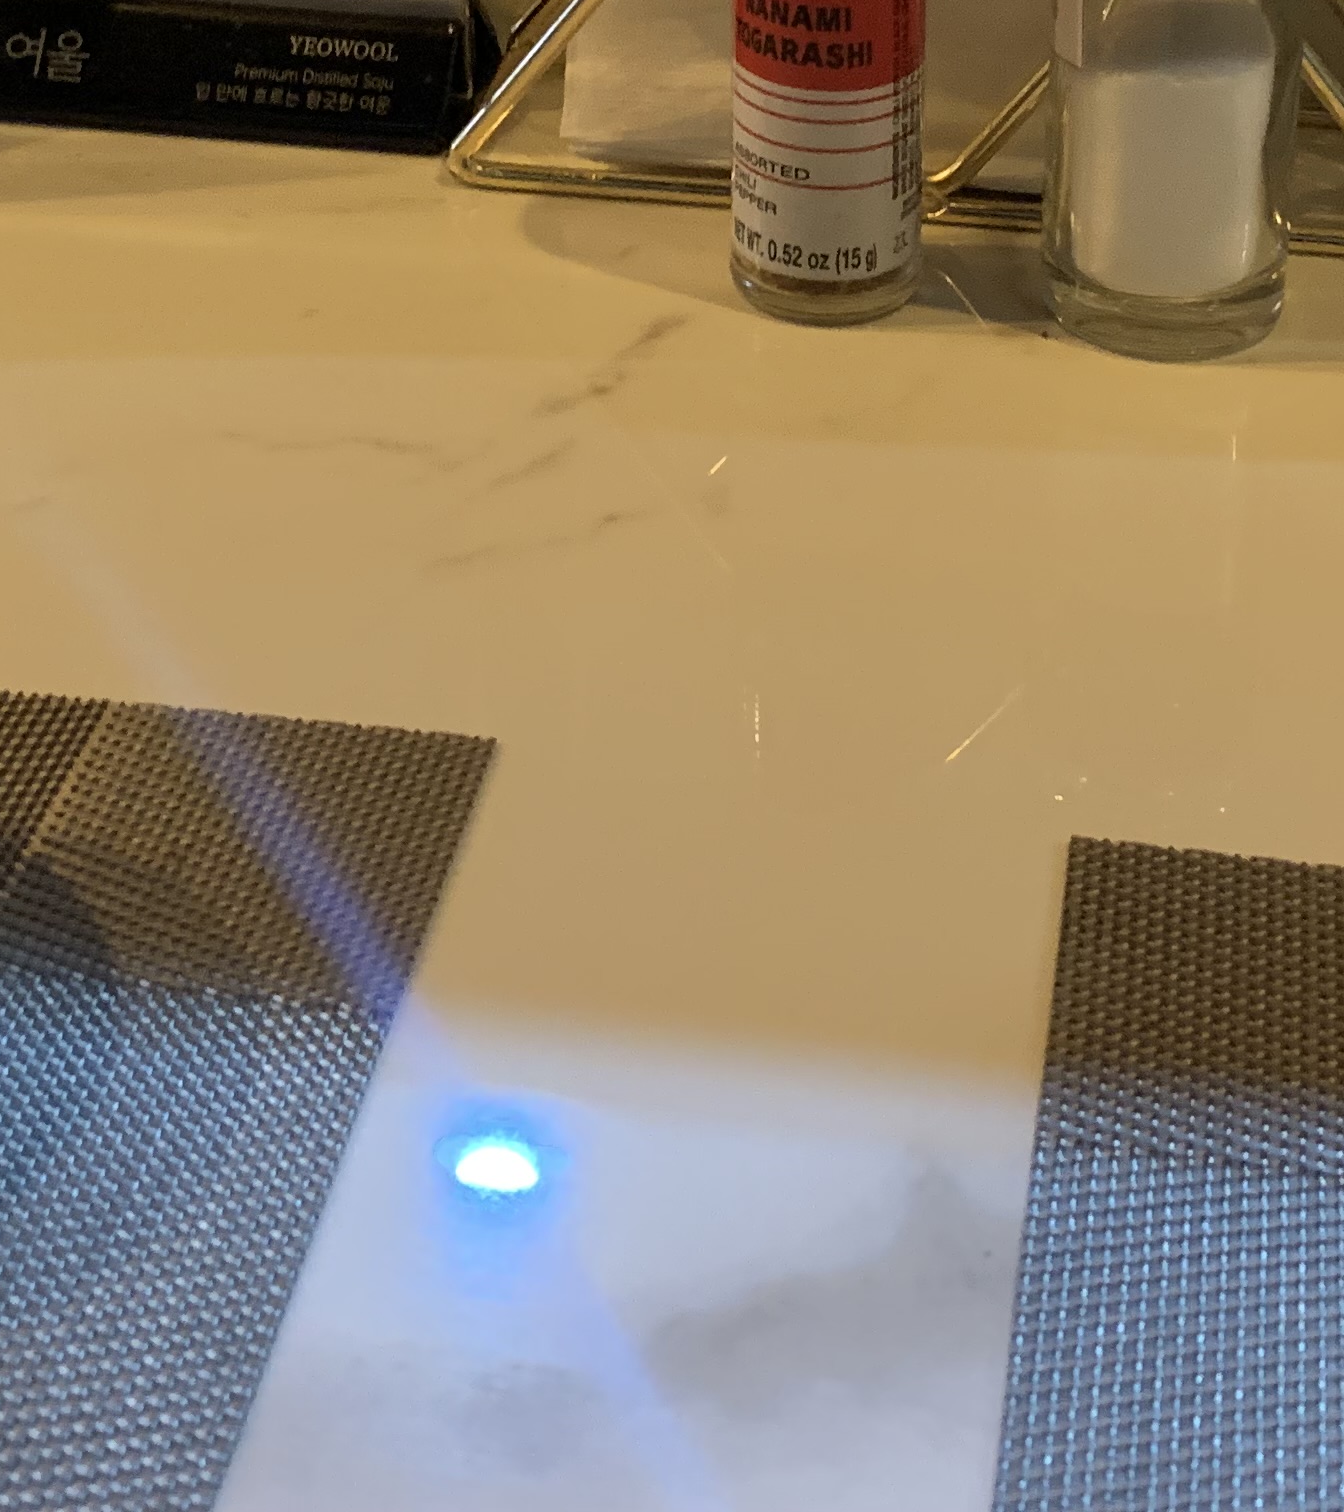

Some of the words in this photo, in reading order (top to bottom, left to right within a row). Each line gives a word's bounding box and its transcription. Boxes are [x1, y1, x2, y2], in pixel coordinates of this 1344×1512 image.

[6, 26, 90, 85] 여울
[290, 35, 399, 62] YEOWOOL
[234, 62, 299, 85] Premium
[302, 67, 359, 88] Distilled
[767, 239, 803, 268] 0.52
[807, 252, 830, 270] oz
